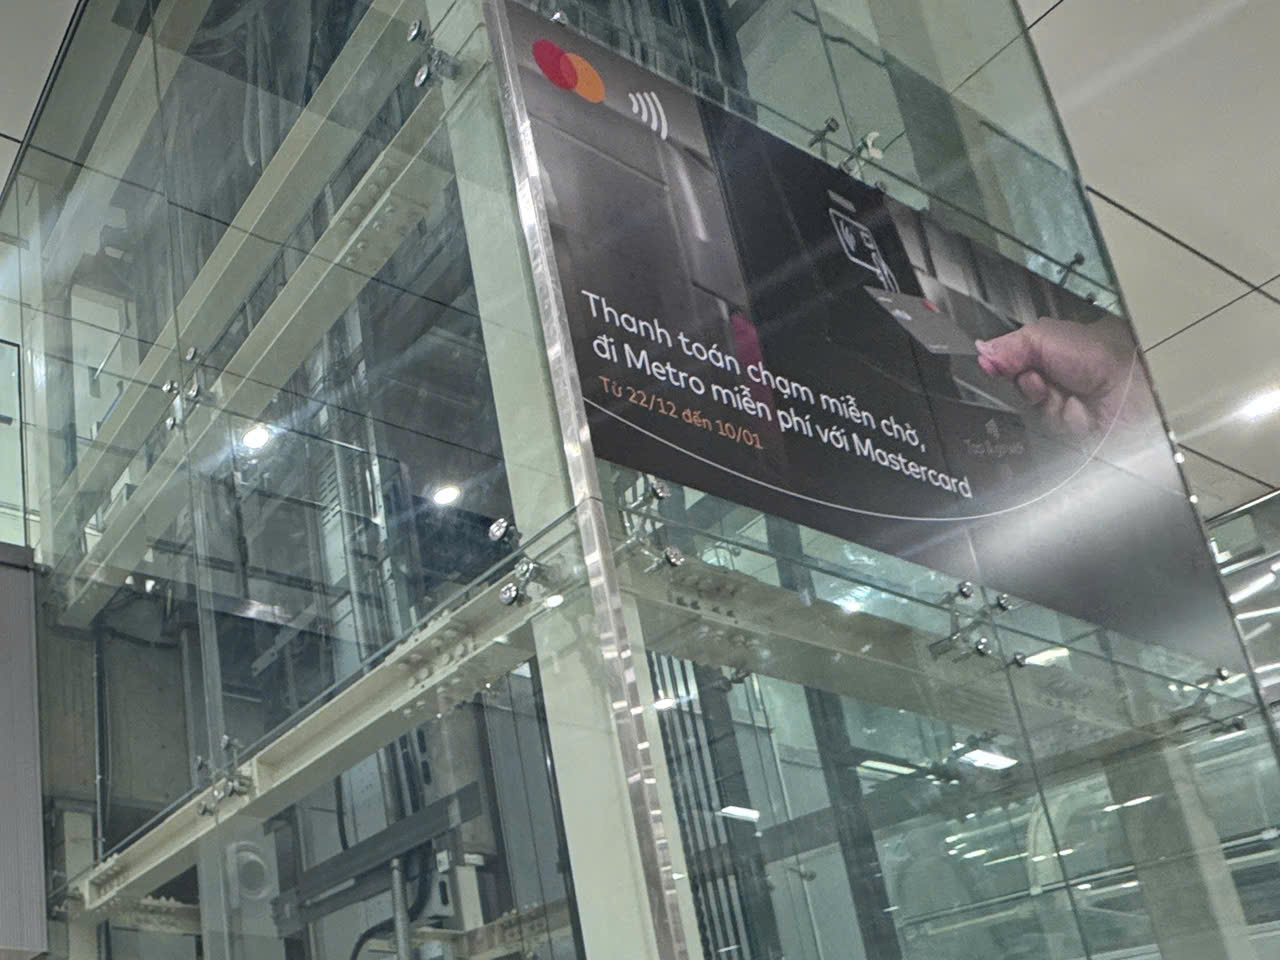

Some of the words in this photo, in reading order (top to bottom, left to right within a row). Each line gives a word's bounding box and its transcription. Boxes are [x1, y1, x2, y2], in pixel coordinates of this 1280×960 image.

[581, 289, 673, 347] Thanh
[677, 331, 741, 376] toán
[746, 361, 815, 405] chạm
[819, 393, 877, 430] miễn
[880, 416, 926, 453] chờ,
[592, 334, 619, 363] đi
[623, 343, 706, 395] Metro
[710, 384, 773, 422] miễn
[776, 408, 814, 438] phí
[815, 425, 850, 452] với
[851, 433, 974, 499] Mastercard
[597, 375, 624, 398] Từ
[626, 386, 679, 419] 22/12
[681, 407, 714, 432] đến
[715, 419, 764, 450] 10/01
